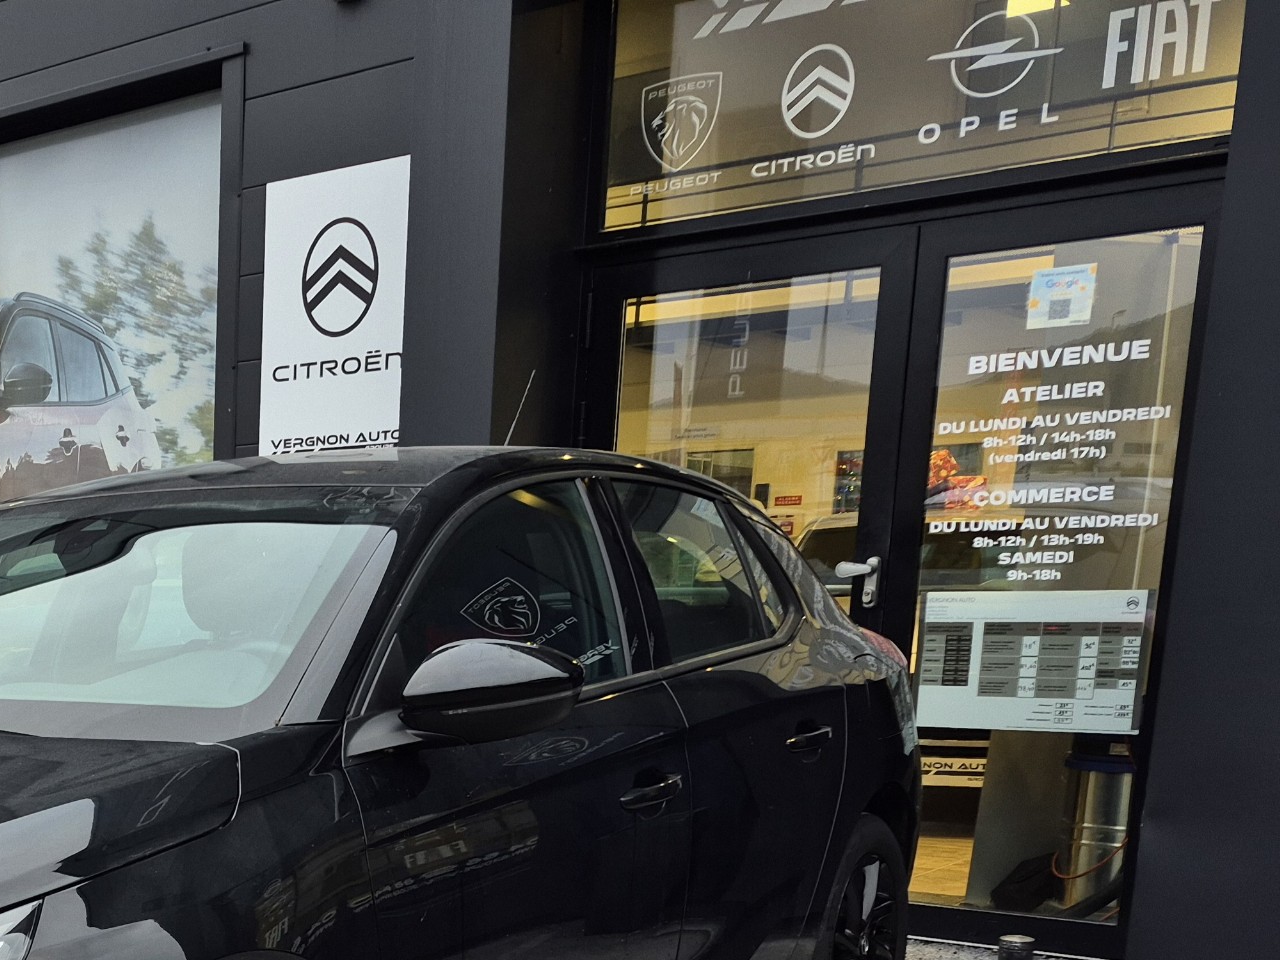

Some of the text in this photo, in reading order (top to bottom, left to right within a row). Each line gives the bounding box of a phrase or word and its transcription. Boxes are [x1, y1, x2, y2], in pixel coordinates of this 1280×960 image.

[1101, 0, 1220, 89] FIAT
[648, 78, 716, 101] PEUGEOT
[918, 101, 1060, 145] OPEL
[629, 171, 722, 198] PEUGEOT
[967, 339, 1152, 375] BIENVENUE
[1001, 381, 1106, 405] ATELIER
[938, 405, 1172, 435] DU LUNDI AU VENDREDI
[270, 429, 400, 451] VERGNON AUTO
[982, 429, 1116, 449] 8h-12h / 14h-18h
[988, 446, 1107, 466] (vendredi 17h)
[973, 485, 1116, 508] COMMERCE
[928, 513, 1159, 535] DU LUNDI AU VENDREDI
[972, 533, 1105, 549] 8h-12h / 13h-19h
[997, 551, 1074, 566] SAMEDI
[1006, 568, 1062, 582] 9h-18h
